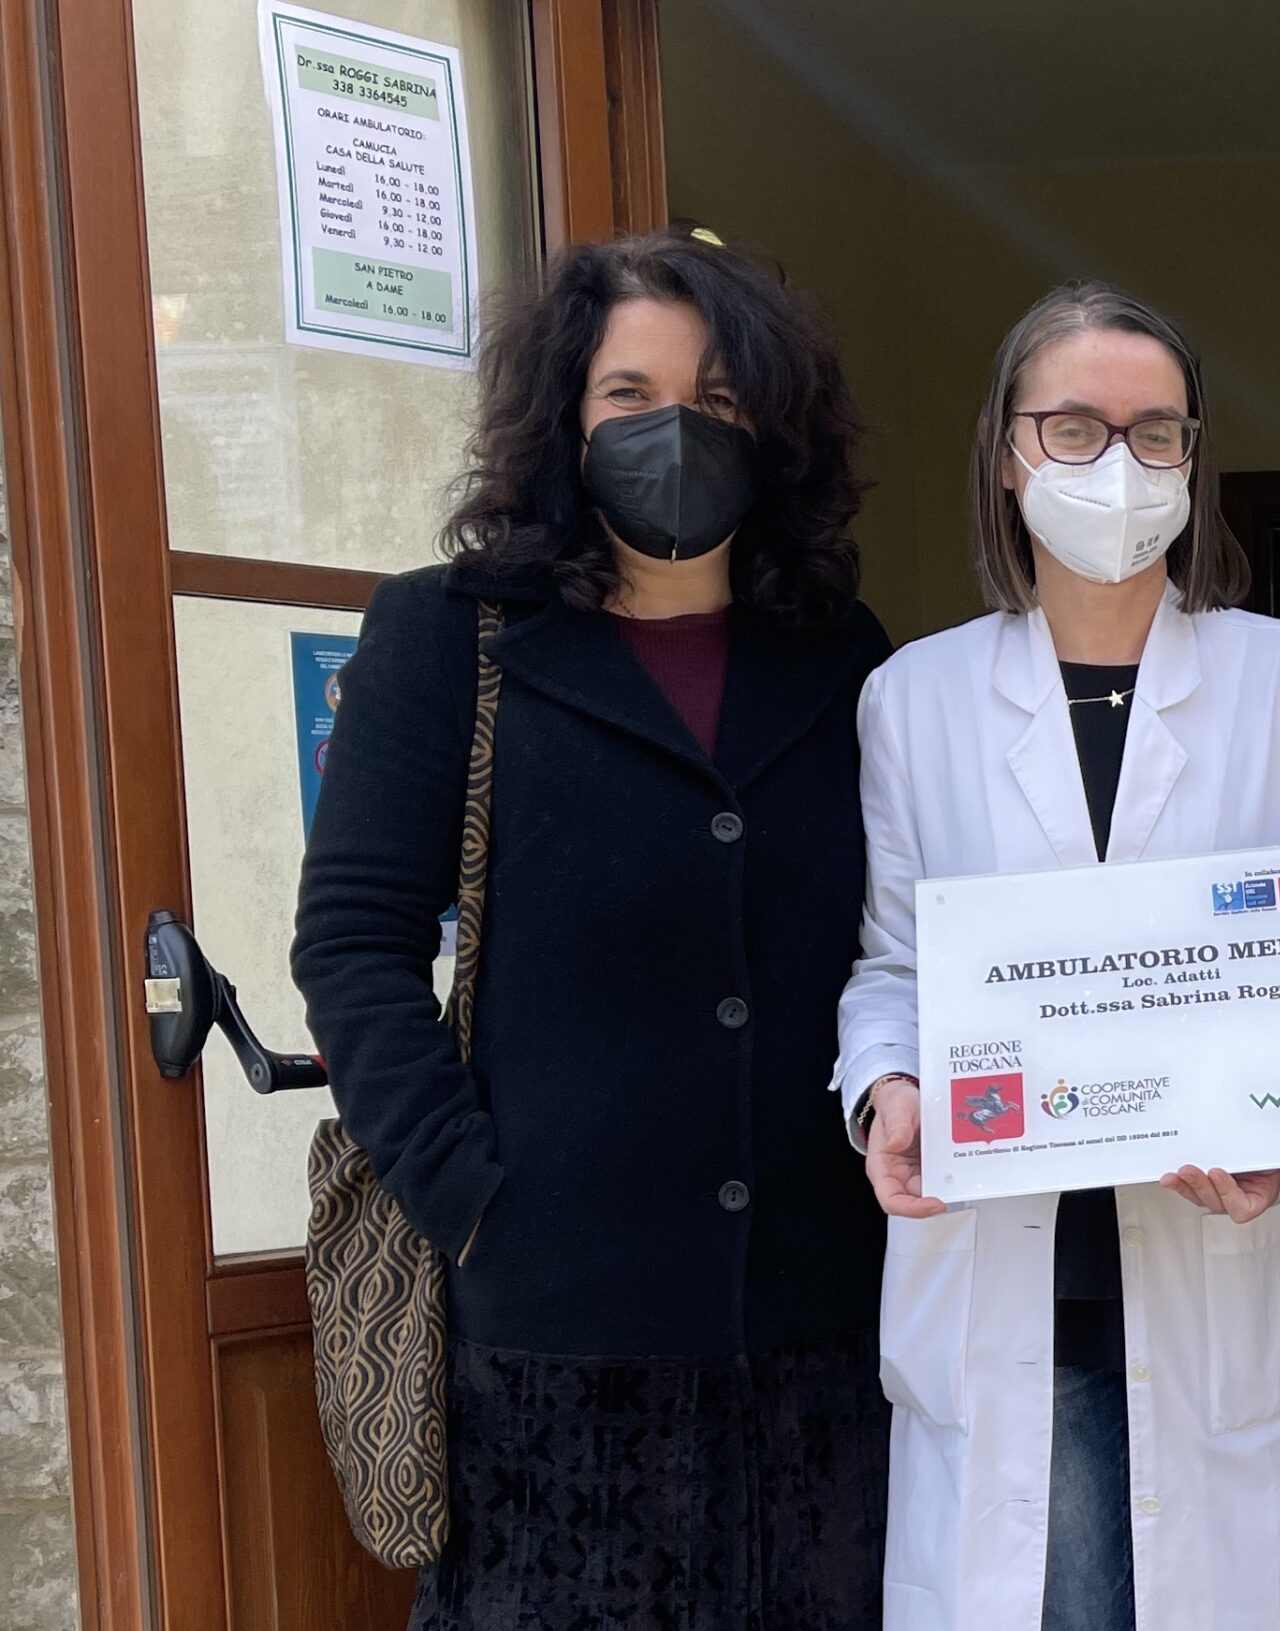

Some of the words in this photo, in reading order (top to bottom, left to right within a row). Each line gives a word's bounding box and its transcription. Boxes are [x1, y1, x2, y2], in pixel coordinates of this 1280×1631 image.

[339, 64, 379, 85] ROGGI
[383, 76, 437, 99] SABRINA
[332, 79, 354, 94] 338
[359, 85, 408, 108] 3364545
[317, 107, 350, 124] ORARI
[352, 138, 398, 156] CAMUCIA
[326, 144, 352, 159] CASA
[356, 151, 385, 166] DELLA
[389, 159, 425, 175] SALUTE
[354, 262, 375, 274] SAN
[378, 266, 414, 282] PIETRO
[366, 281, 373, 290] A
[376, 282, 404, 295] DAME
[985, 944, 1219, 984] AMBULATORIO
[1121, 975, 1158, 988] Loc.
[1163, 967, 1221, 985] Adatti
[1039, 999, 1135, 1019] Dott.ssa
[1140, 988, 1231, 1009] Sabrina
[949, 1040, 1022, 1059] REGIONE
[949, 1055, 1023, 1073] TOSCANA
[1081, 1077, 1170, 1095] COOPERATIVE
[1090, 1087, 1162, 1106] COMUNITÀ
[1082, 1101, 1146, 1118] TOSCANE
